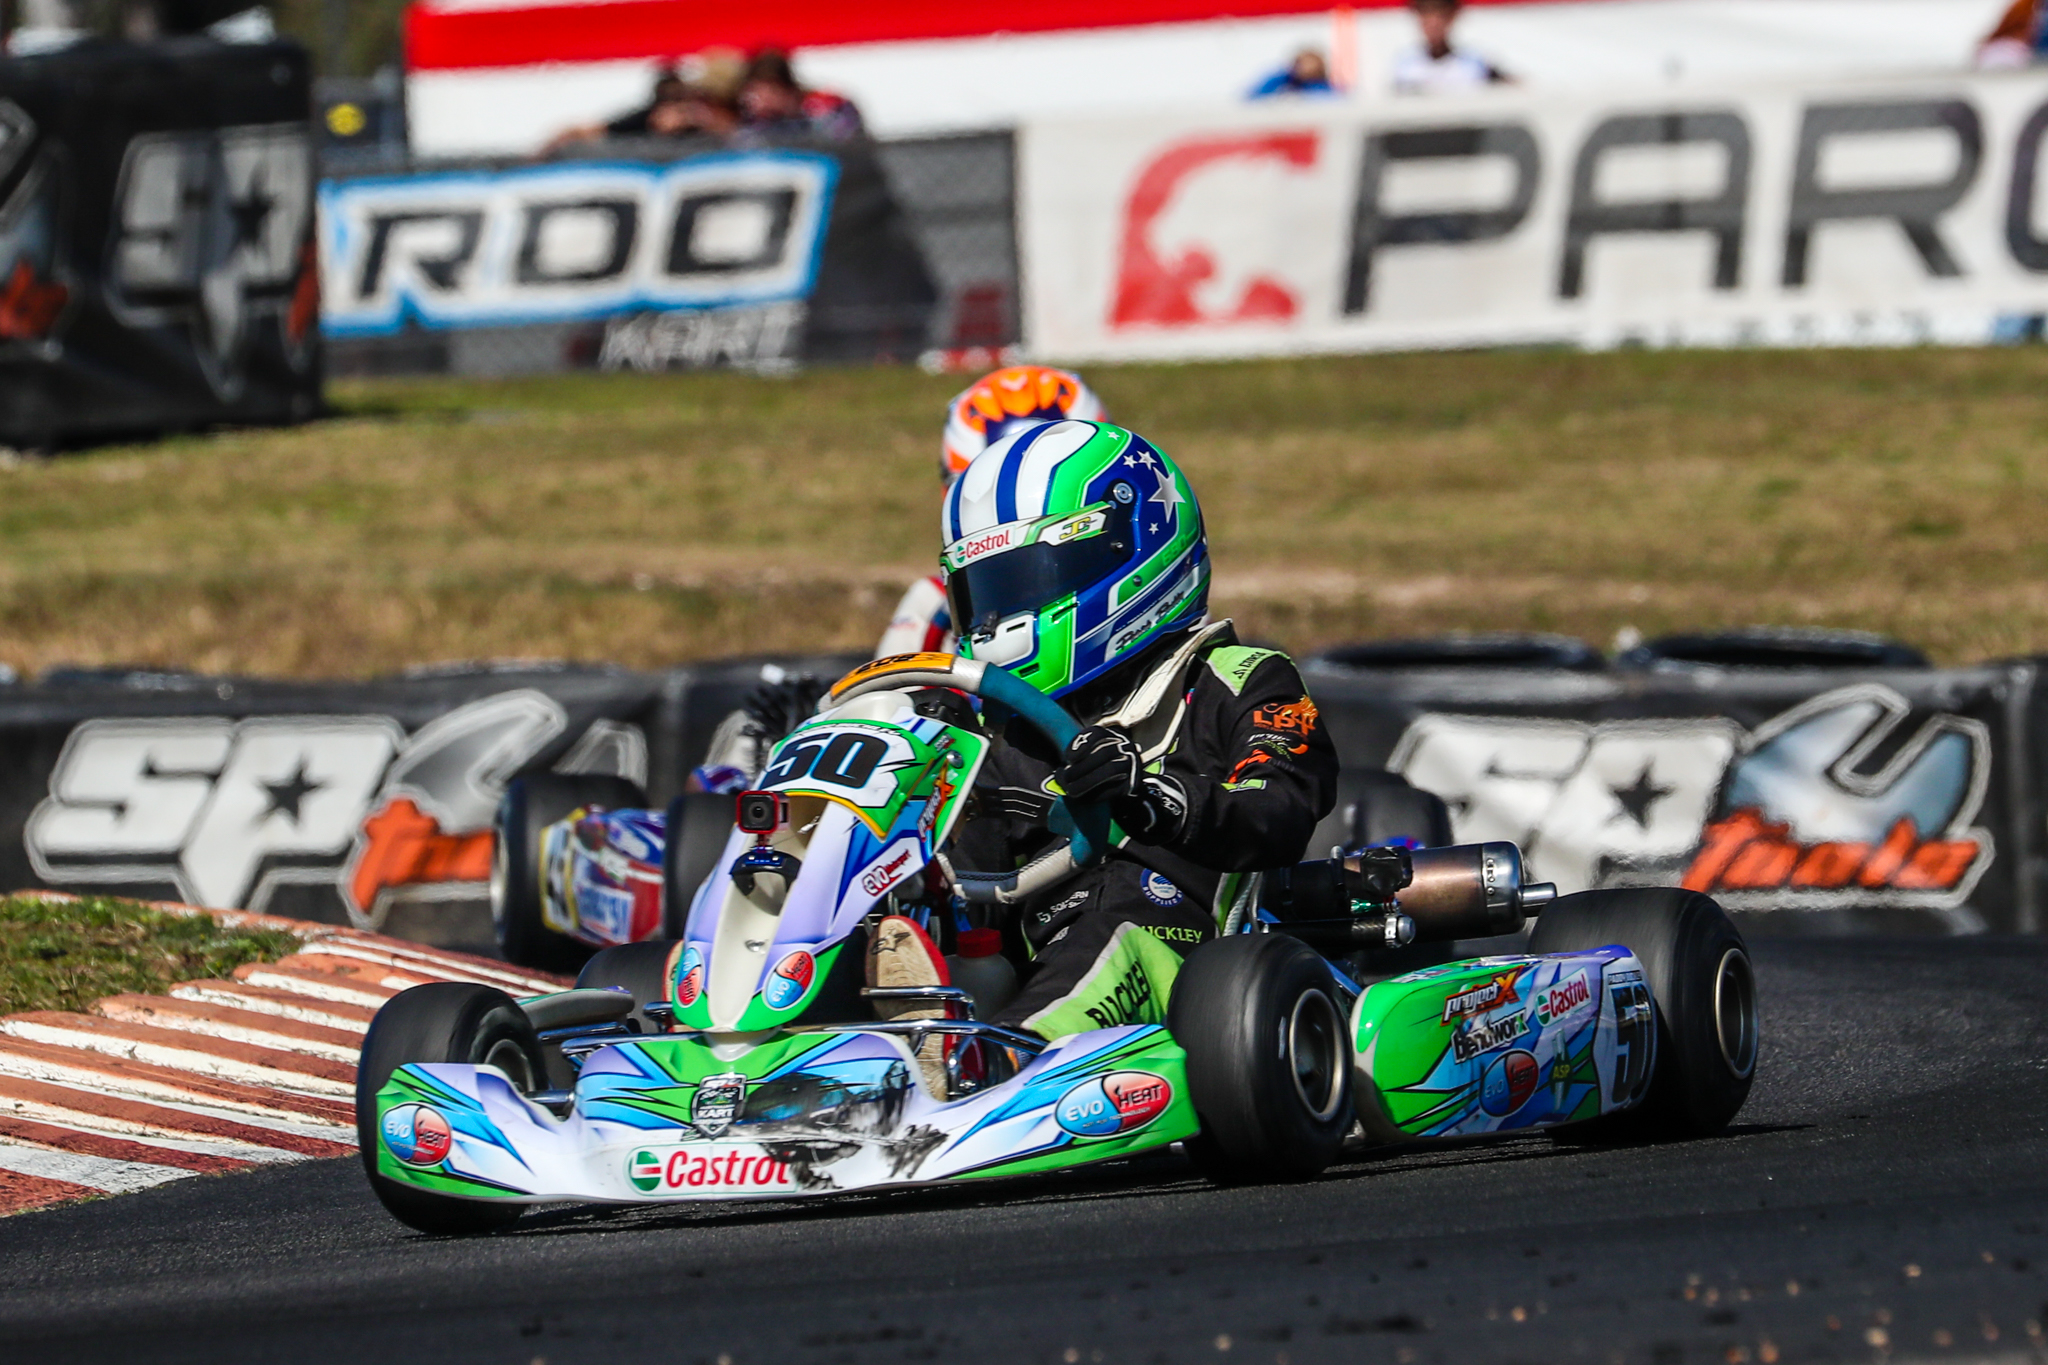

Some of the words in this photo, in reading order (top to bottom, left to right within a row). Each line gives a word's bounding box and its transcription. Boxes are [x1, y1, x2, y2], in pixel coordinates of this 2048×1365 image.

[357, 187, 800, 300] RDO
[965, 528, 1011, 560] Castrol
[758, 731, 890, 791] 50
[35, 727, 402, 908] SP
[1402, 728, 1738, 892] SP
[1549, 972, 1590, 1018] Castrol
[1552, 1064, 1570, 1080] ASP
[1065, 1100, 1104, 1121] EVO
[1119, 1085, 1163, 1109] HEAT
[665, 1150, 790, 1187] Castrol
